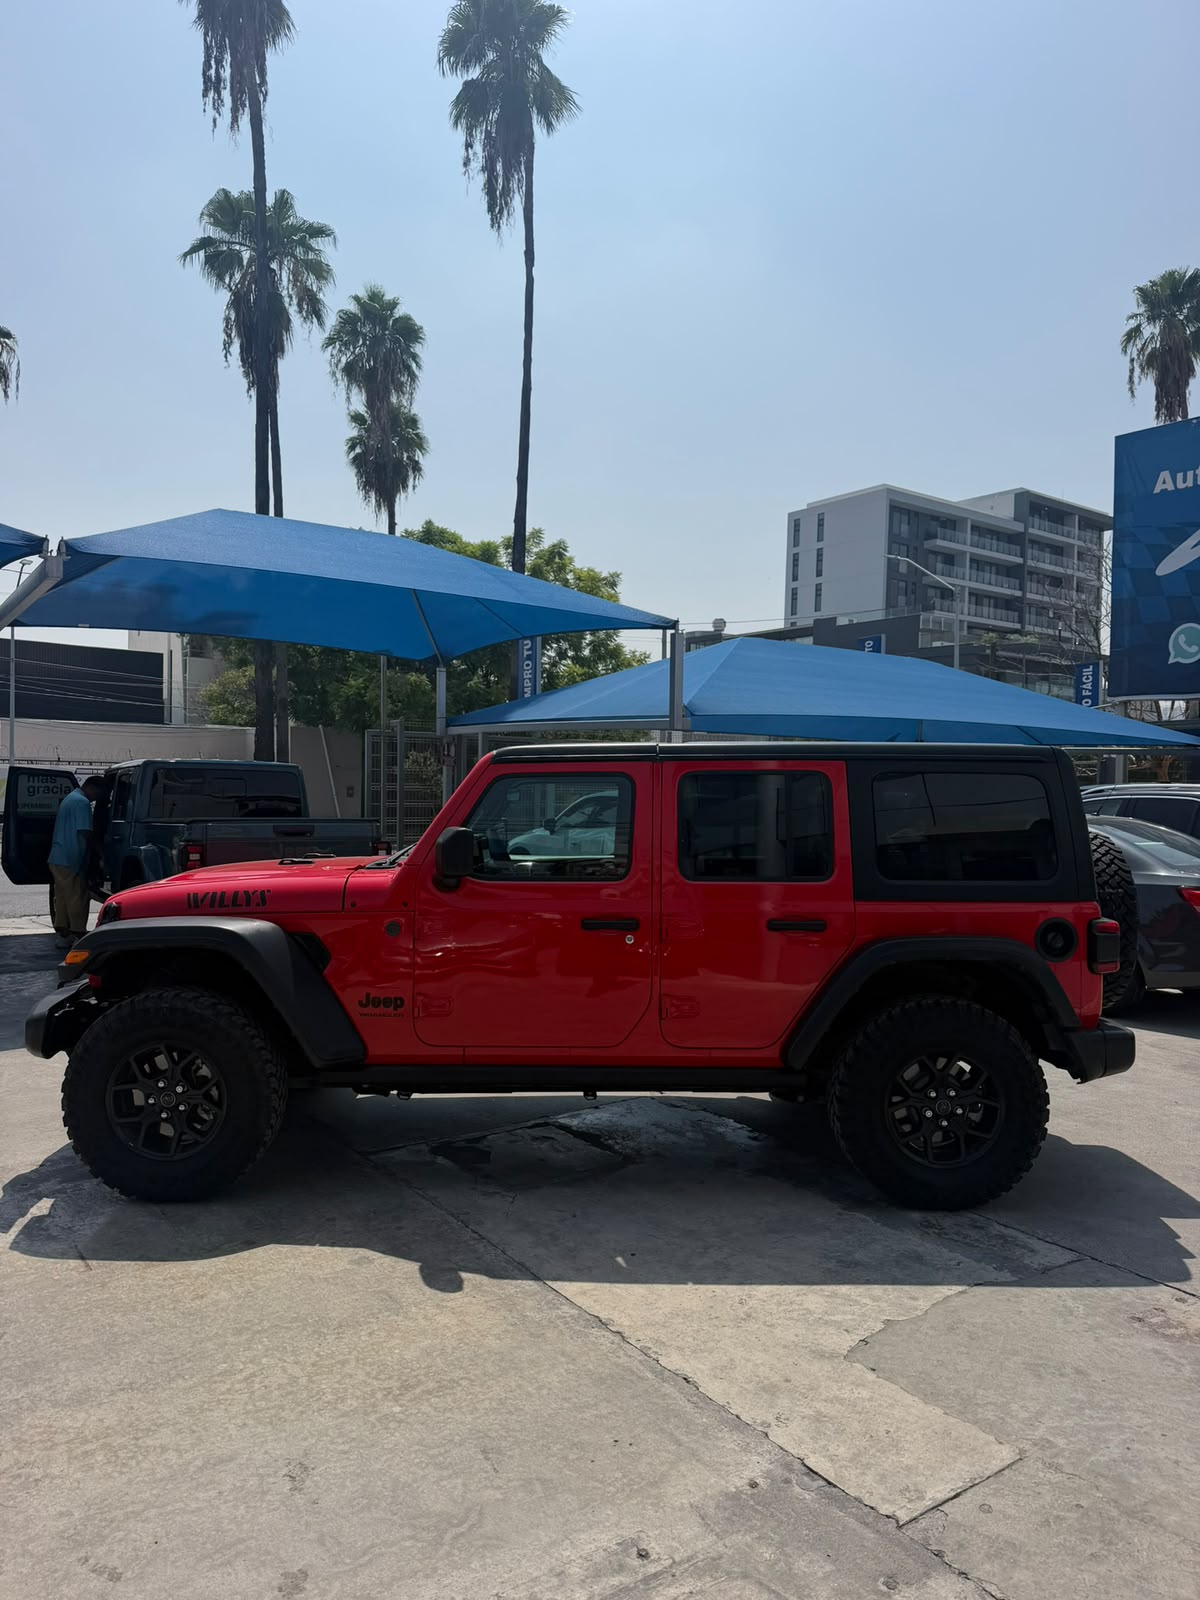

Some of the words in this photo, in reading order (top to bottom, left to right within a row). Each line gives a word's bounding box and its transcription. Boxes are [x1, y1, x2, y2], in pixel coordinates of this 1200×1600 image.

[1080, 665, 1093, 696] FÁCIL
[186, 888, 272, 910] WILLYS
[357, 992, 406, 1011] Jeep
